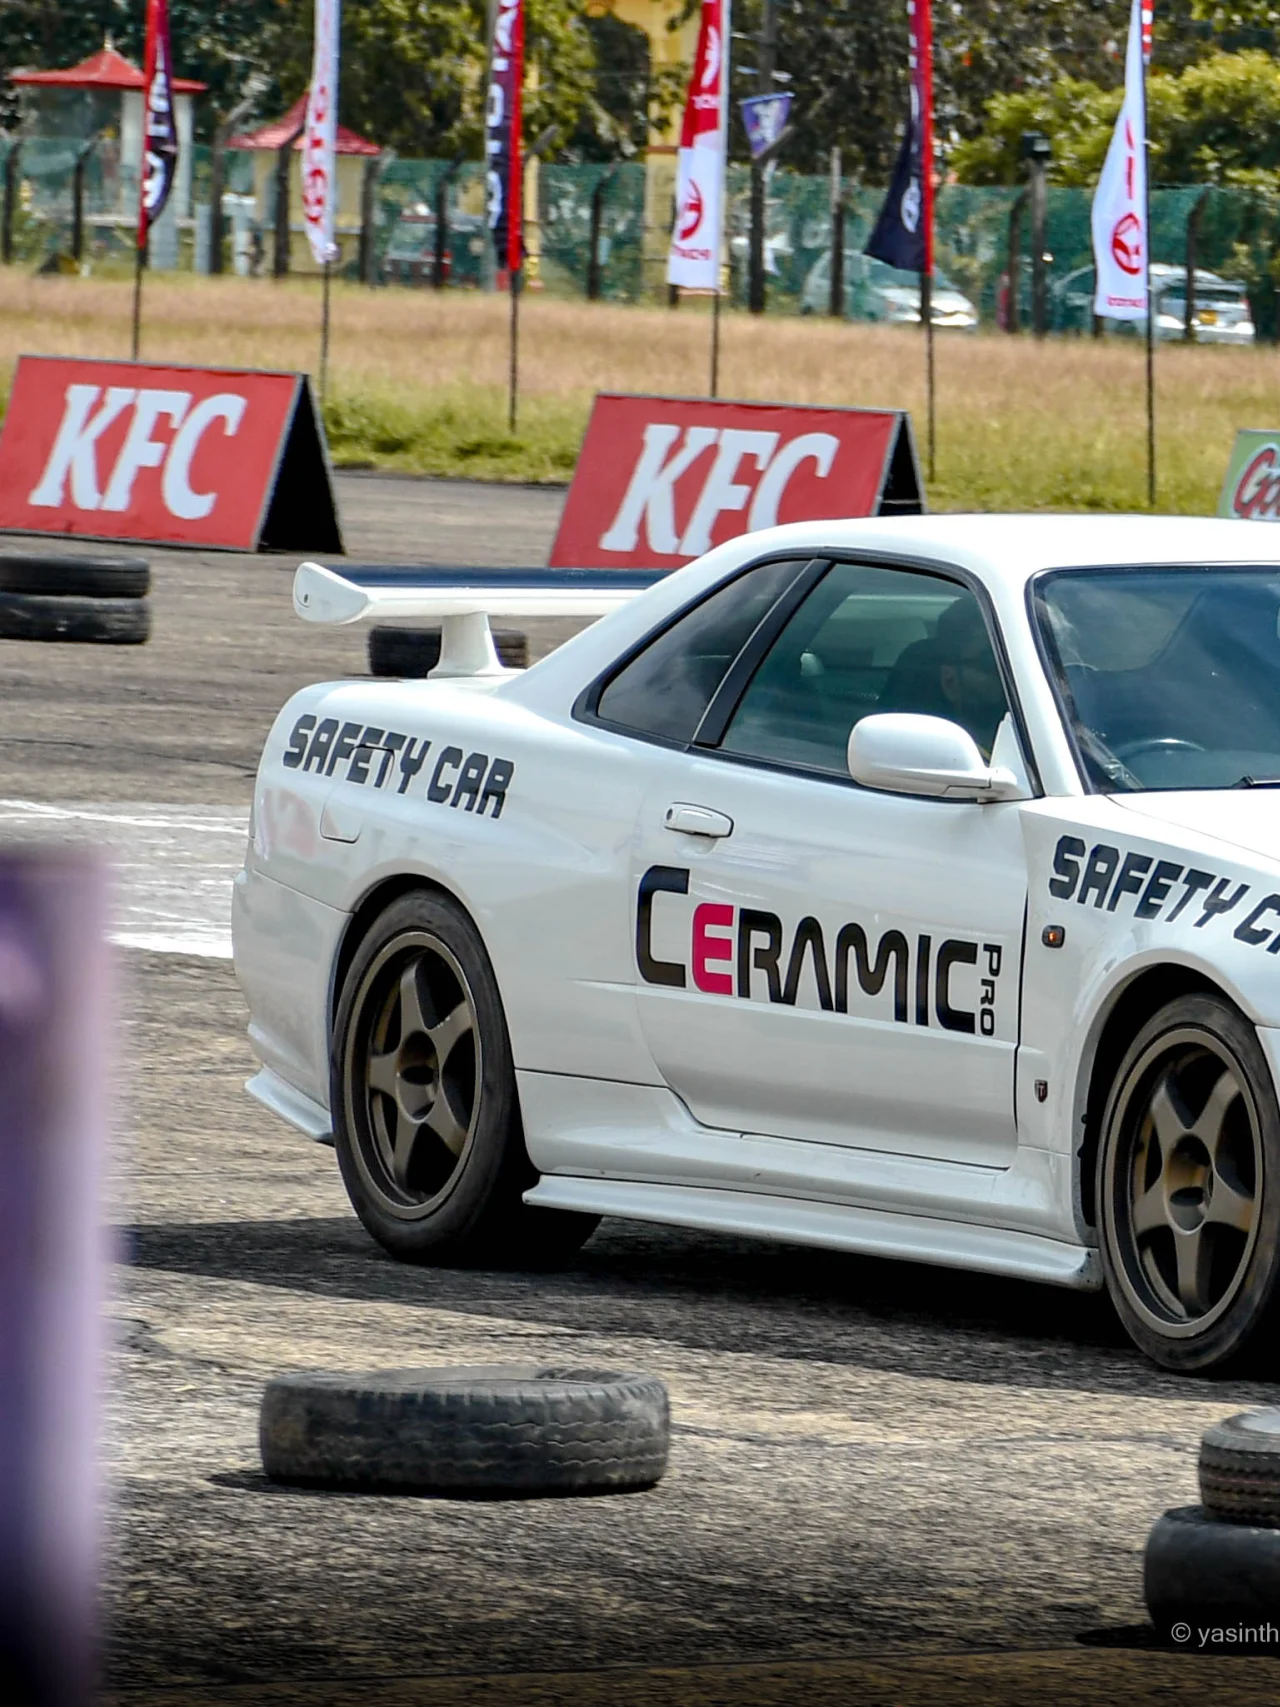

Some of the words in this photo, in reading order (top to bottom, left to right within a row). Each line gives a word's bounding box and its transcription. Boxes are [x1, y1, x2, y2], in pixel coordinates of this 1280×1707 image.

[29, 384, 248, 519] KFC
[598, 423, 841, 557] KFC
[282, 714, 432, 795] SAFETY
[427, 746, 515, 819] CAR
[1048, 834, 1251, 928] SAFETY
[635, 864, 979, 1035] CERAMIC
[980, 943, 1003, 1037] PRO
